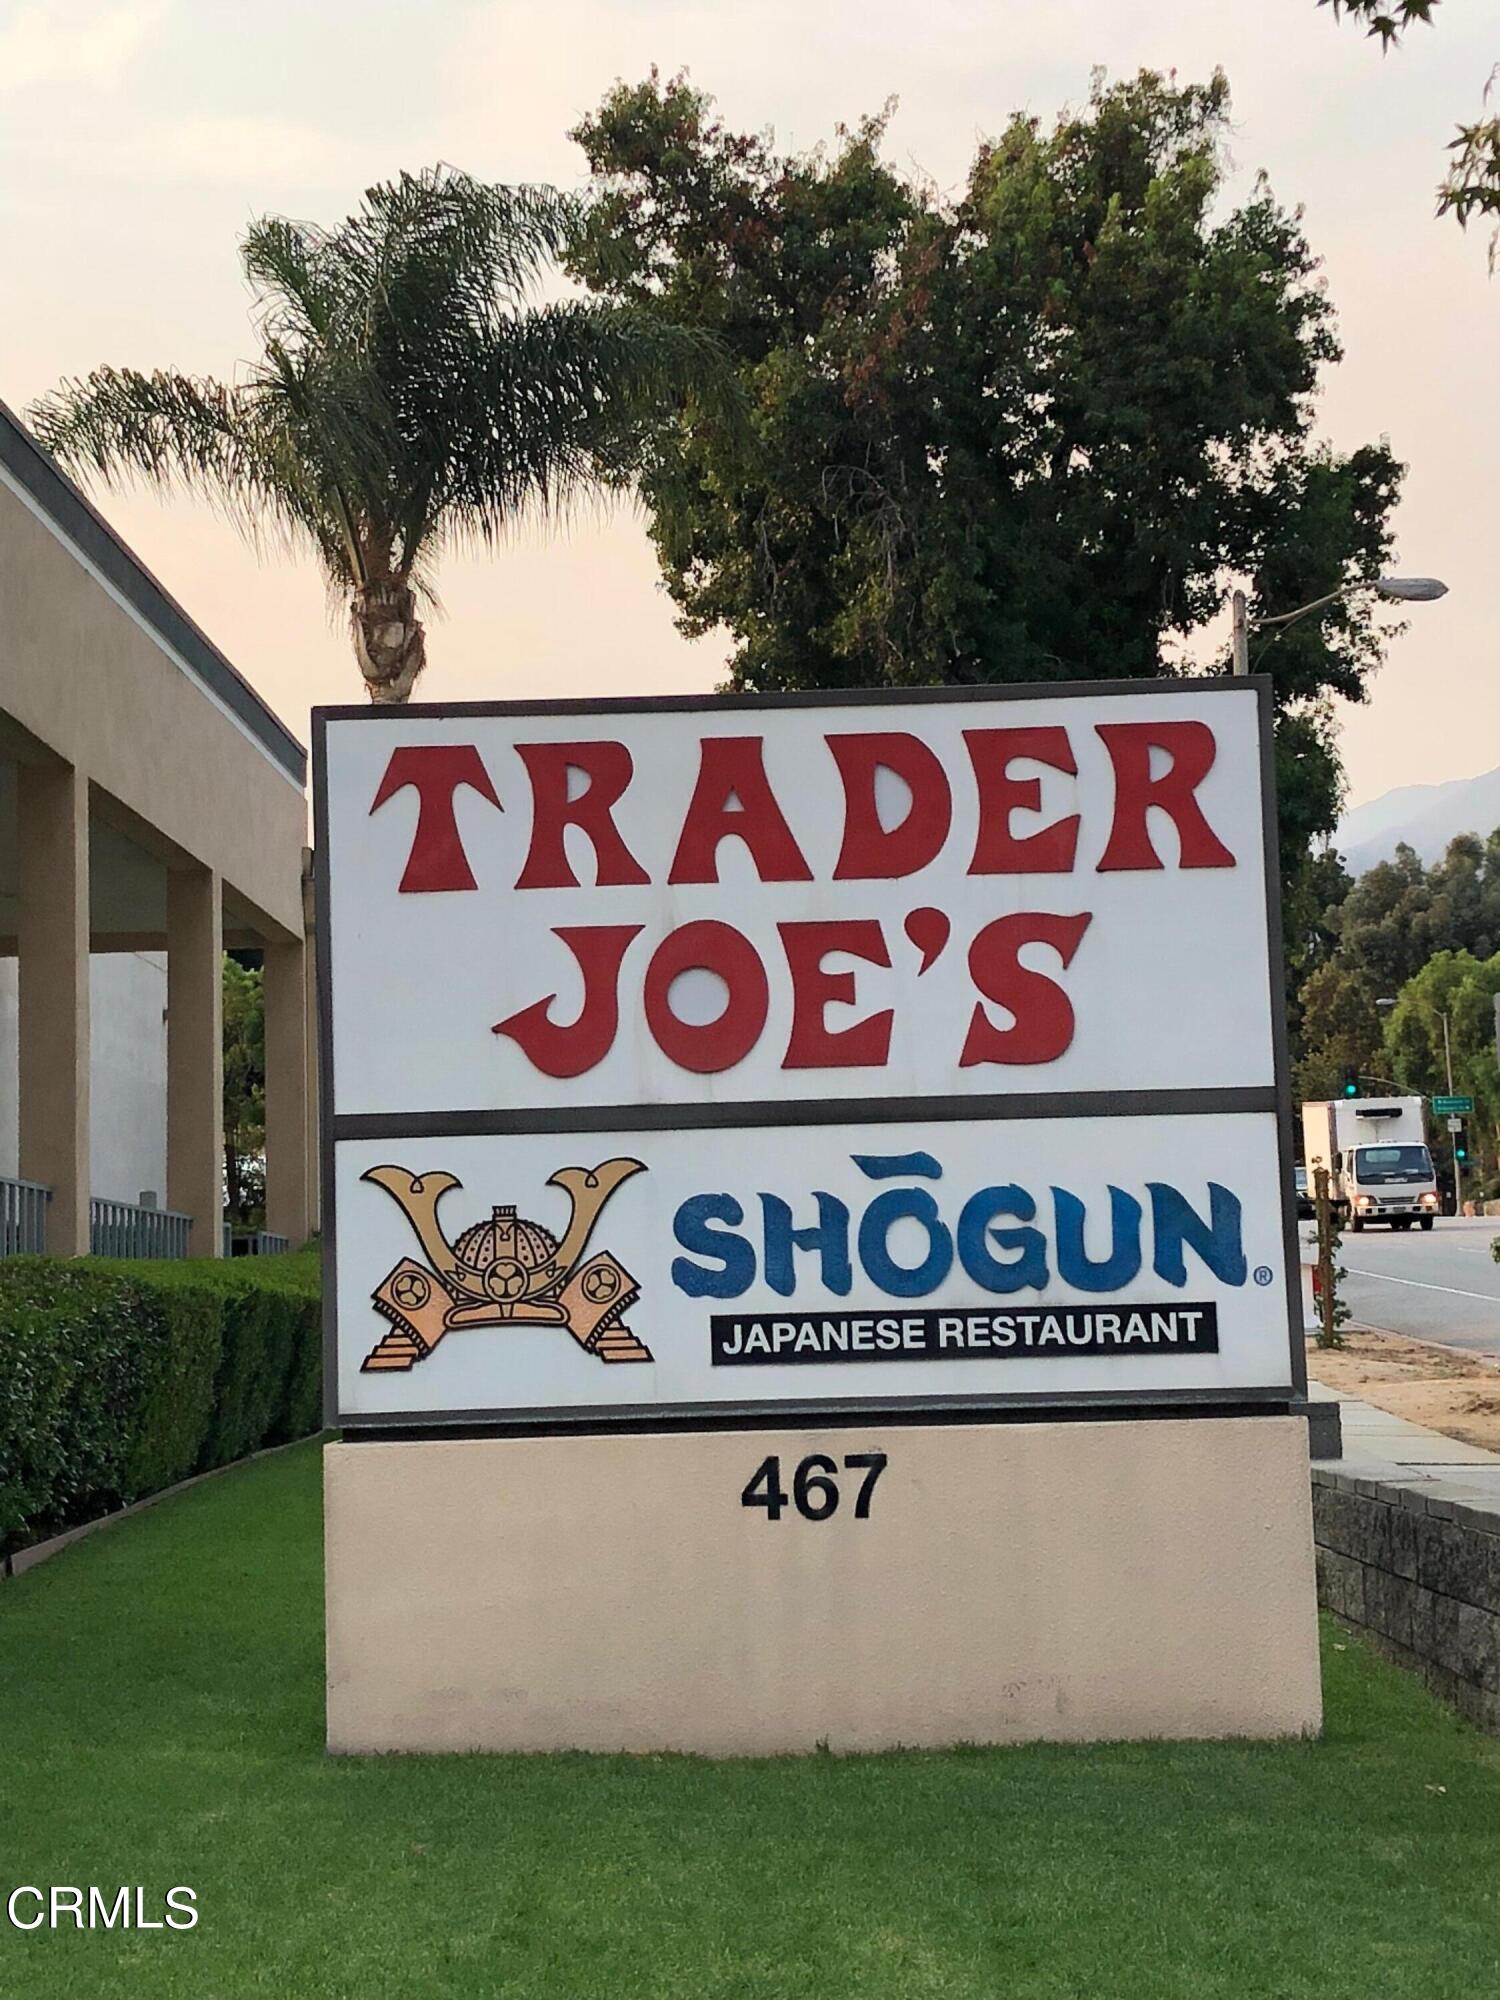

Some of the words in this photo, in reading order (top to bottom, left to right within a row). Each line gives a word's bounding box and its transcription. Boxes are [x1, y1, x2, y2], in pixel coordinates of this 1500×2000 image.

[370, 720, 1236, 893] TRADER
[494, 907, 1093, 1078] JOE'S
[721, 1317, 926, 1355] JAPANESE
[938, 1311, 1204, 1348] RESTAURANT
[741, 1452, 889, 1522] 467
